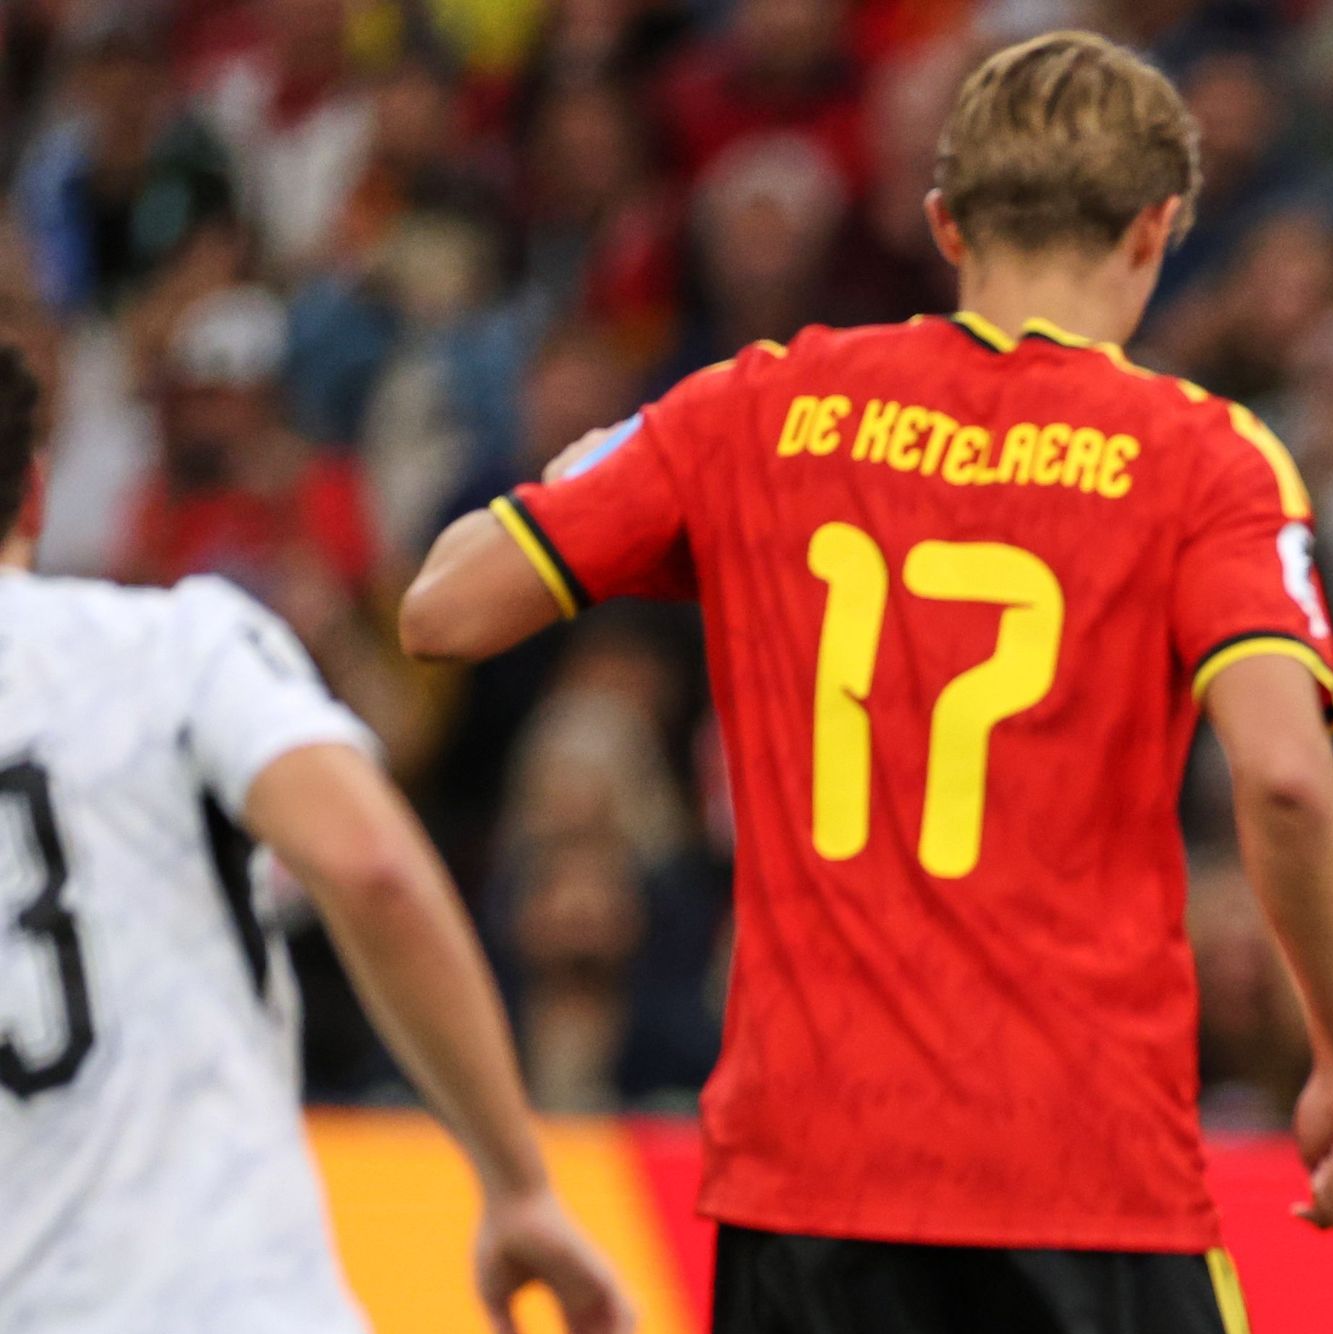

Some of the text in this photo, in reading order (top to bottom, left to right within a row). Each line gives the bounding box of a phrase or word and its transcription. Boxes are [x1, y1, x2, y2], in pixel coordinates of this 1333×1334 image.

[777, 394, 1141, 499] DE KETELAERE
[807, 521, 1064, 879] 17
